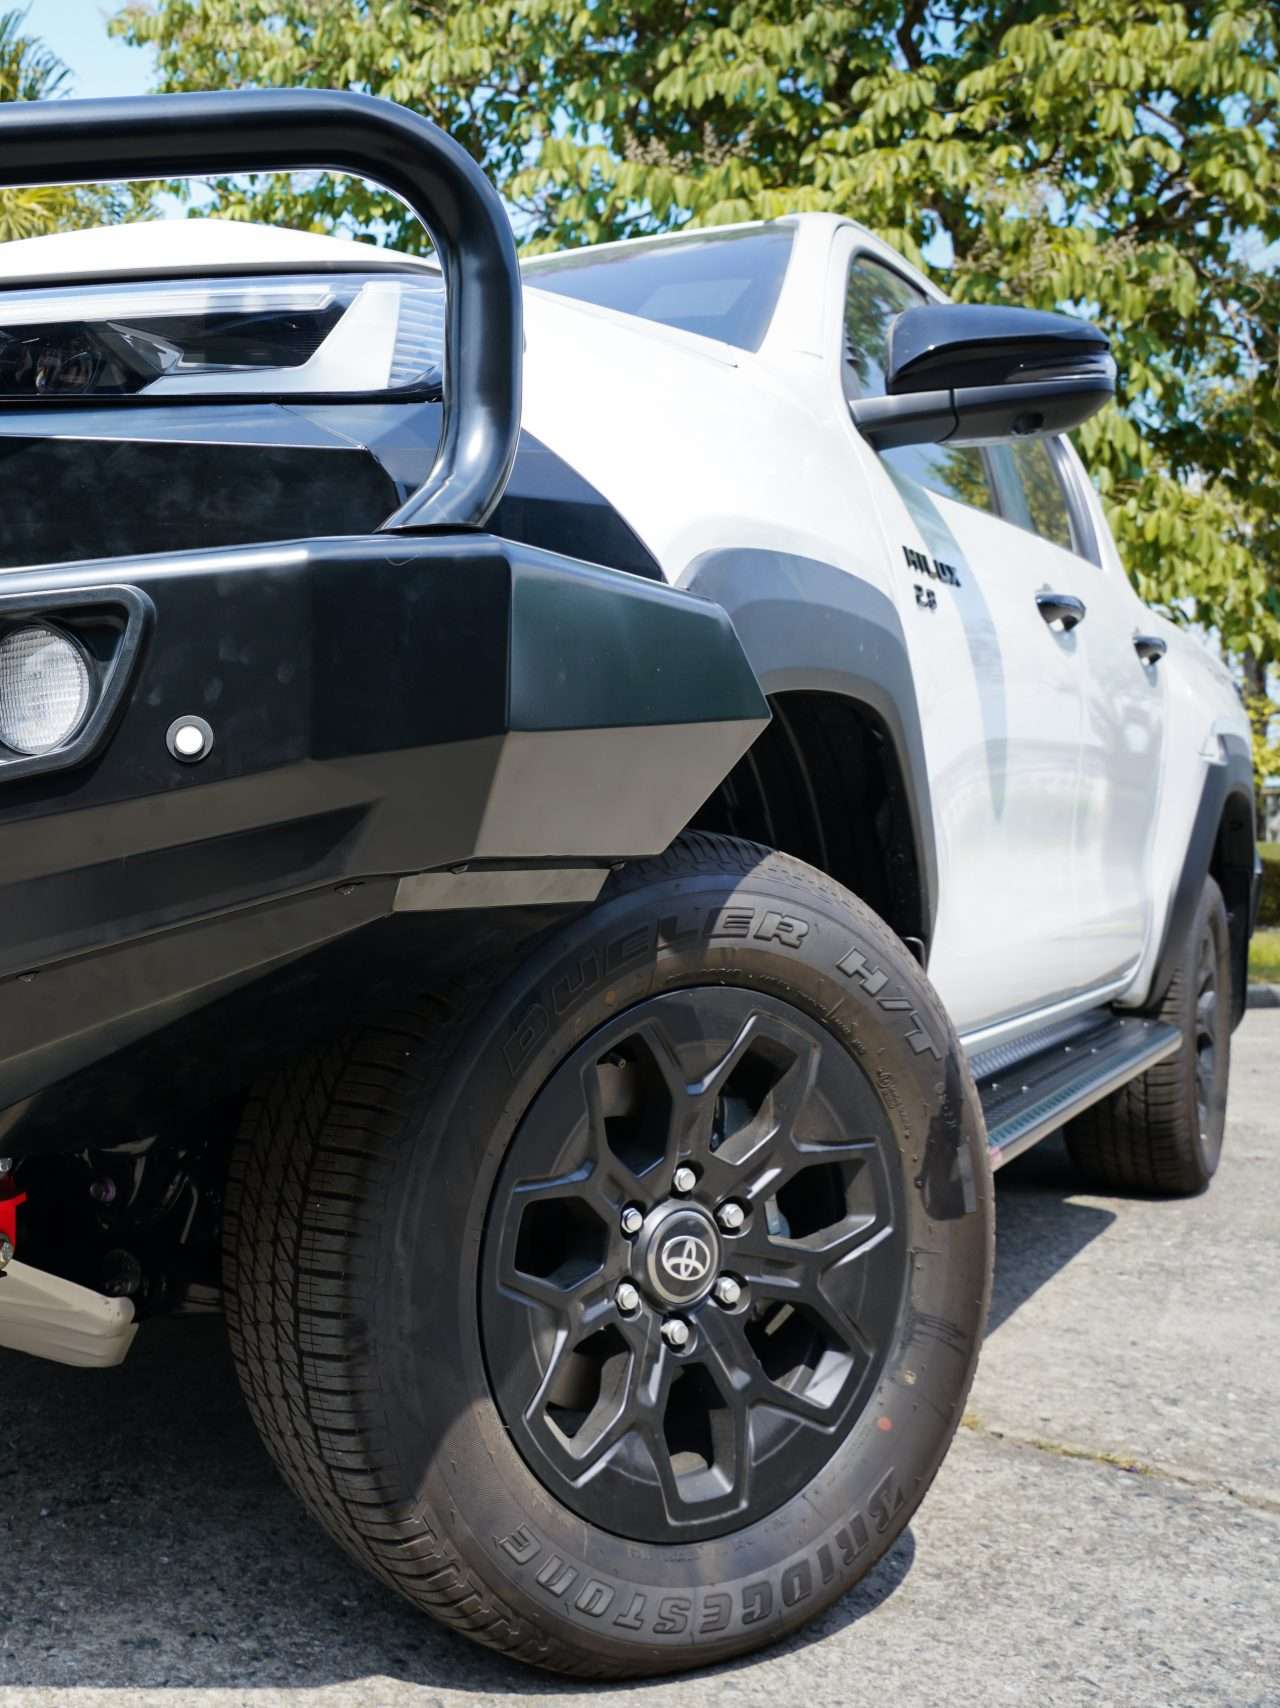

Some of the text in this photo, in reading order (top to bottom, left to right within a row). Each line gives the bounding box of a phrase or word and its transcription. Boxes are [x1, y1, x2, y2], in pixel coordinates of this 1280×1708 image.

[902, 545, 961, 588] HILUX
[503, 906, 943, 1078] DUELER H/T
[494, 1467, 906, 1635] BRIDGESTONE
